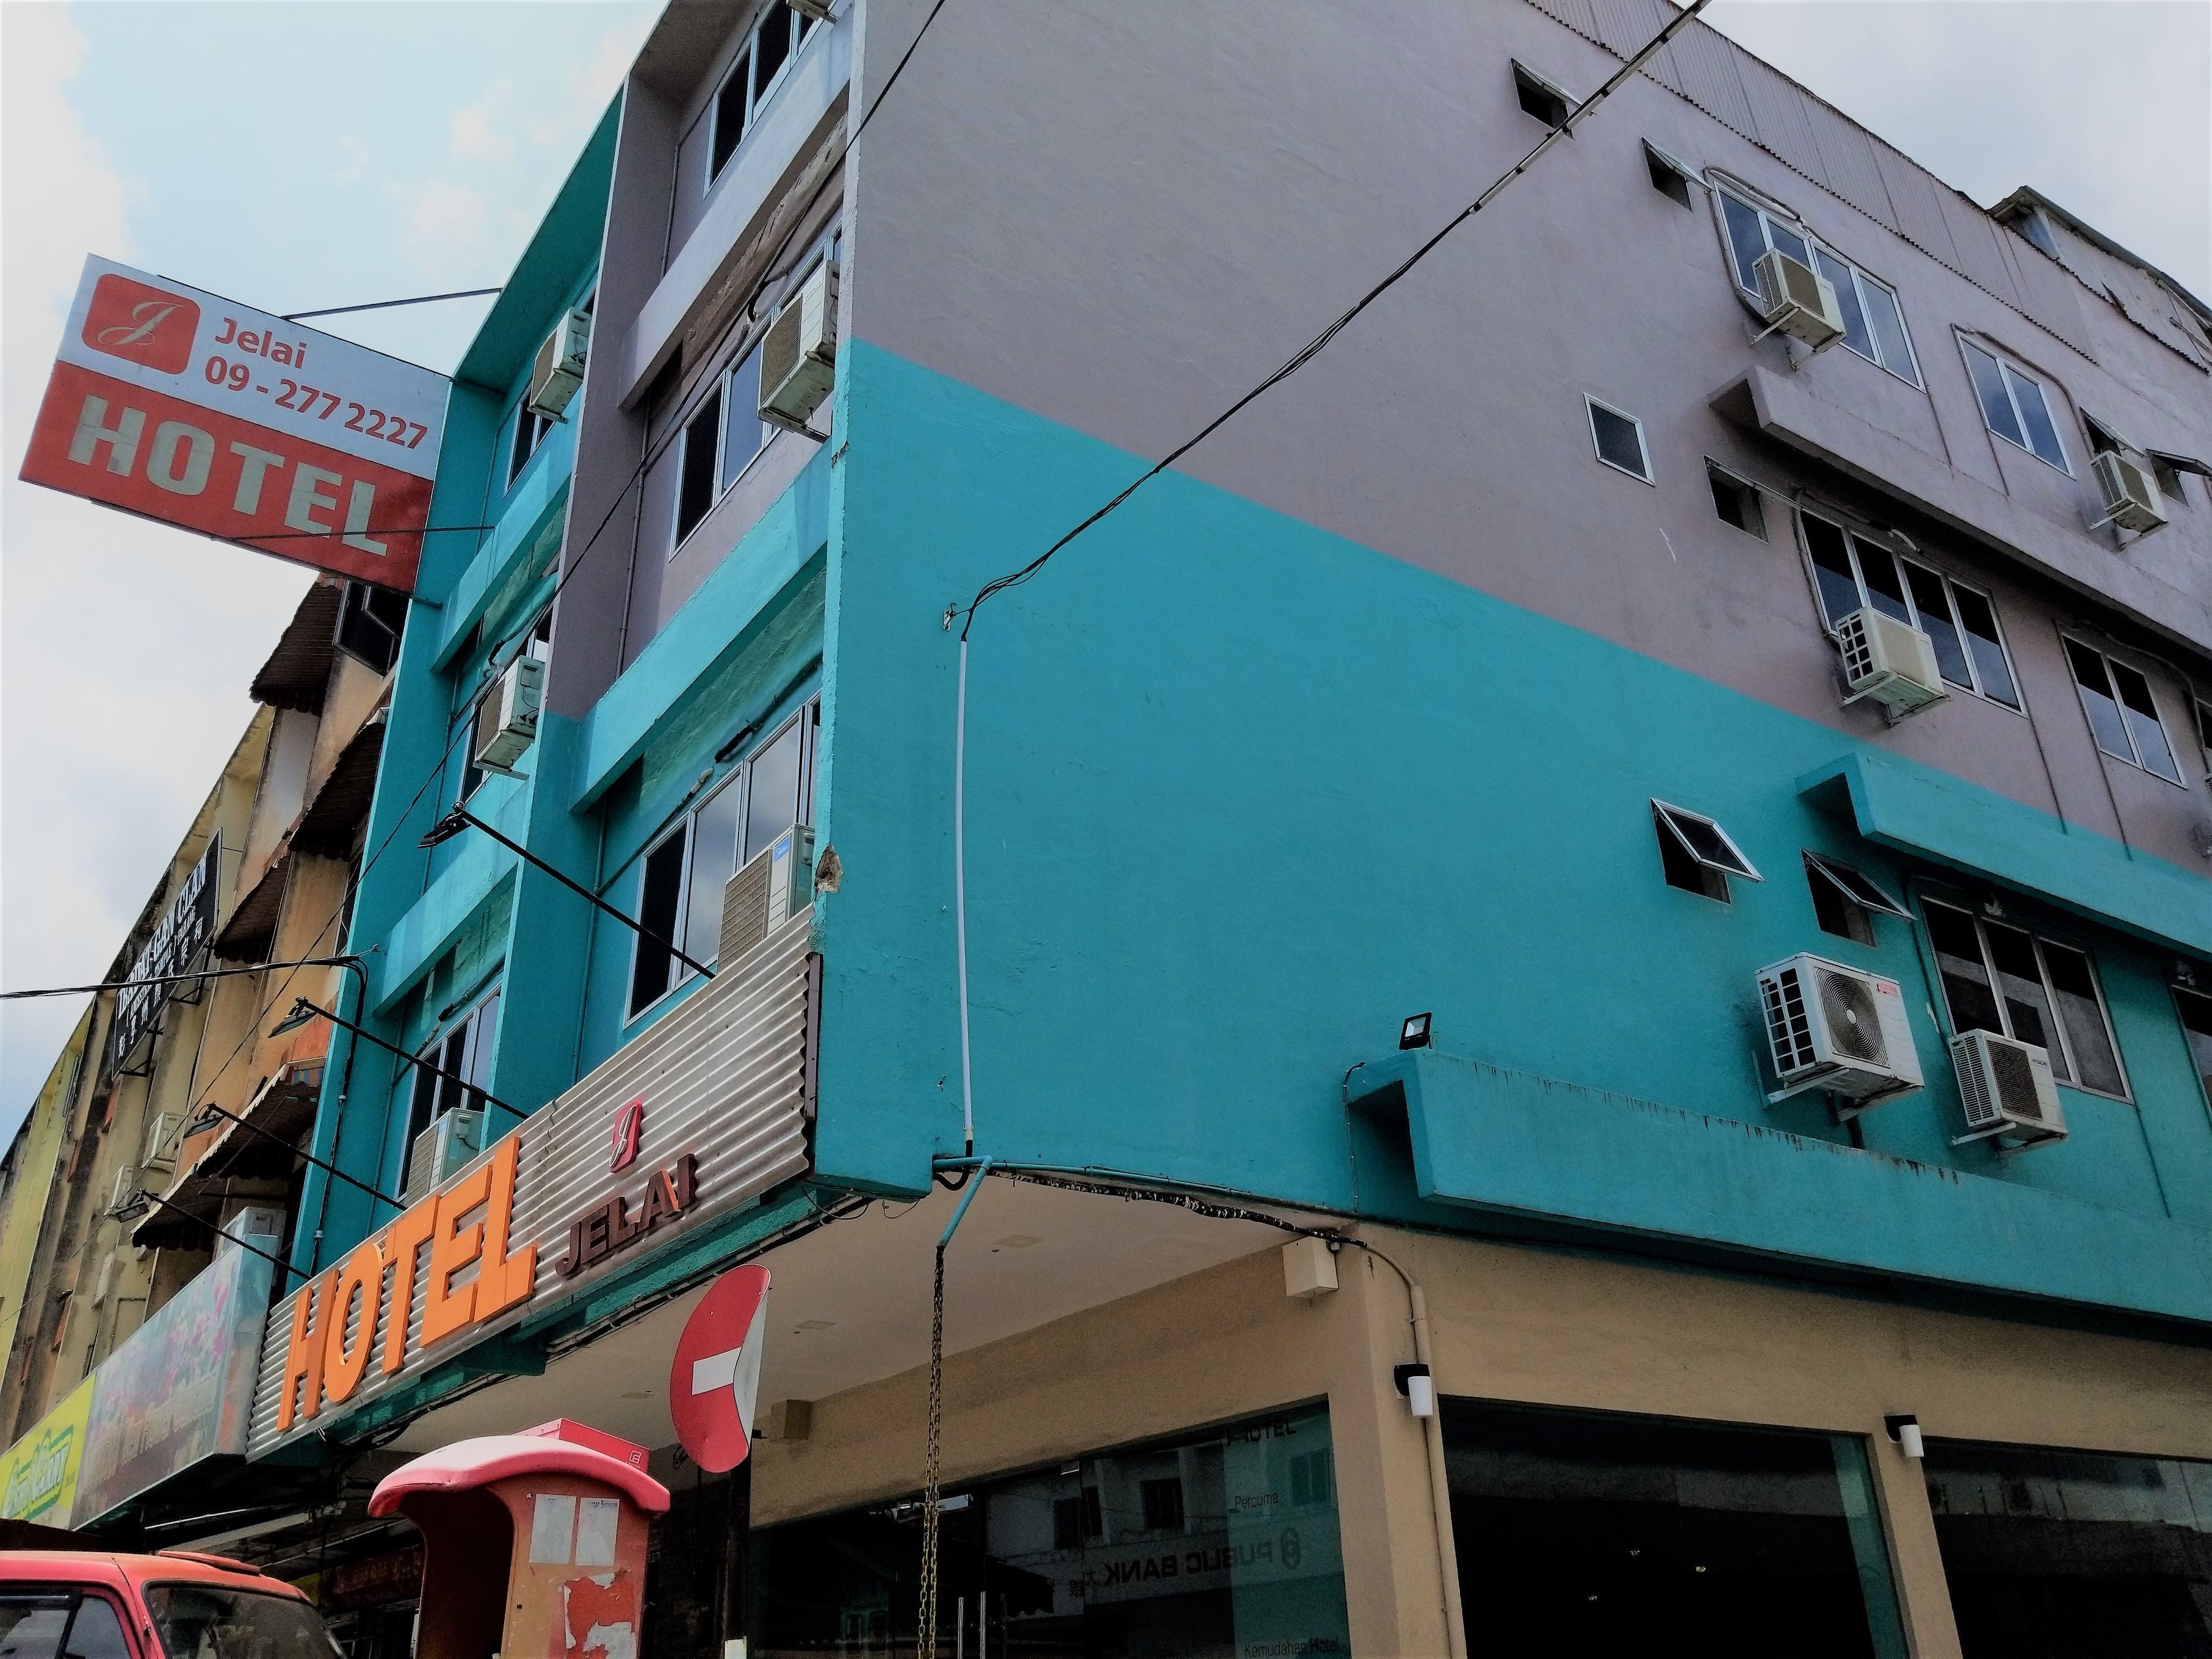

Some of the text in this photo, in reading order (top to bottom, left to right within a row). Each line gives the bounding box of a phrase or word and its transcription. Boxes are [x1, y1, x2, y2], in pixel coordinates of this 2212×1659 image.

[215, 317, 307, 369] Jelai
[344, 402, 428, 449] 2227
[68, 394, 388, 557] HOTEL
[153, 908, 175, 962] GAN
[178, 855, 207, 924] CLAN
[178, 905, 196, 945] PAHANG
[555, 1153, 695, 1276] JELAI
[277, 1137, 537, 1433] HOTEL
[1227, 1417, 1296, 1446] HOTEL
[1235, 1493, 1279, 1510] Percuma
[1245, 1636, 1339, 1658] Kemudahan Hotel
